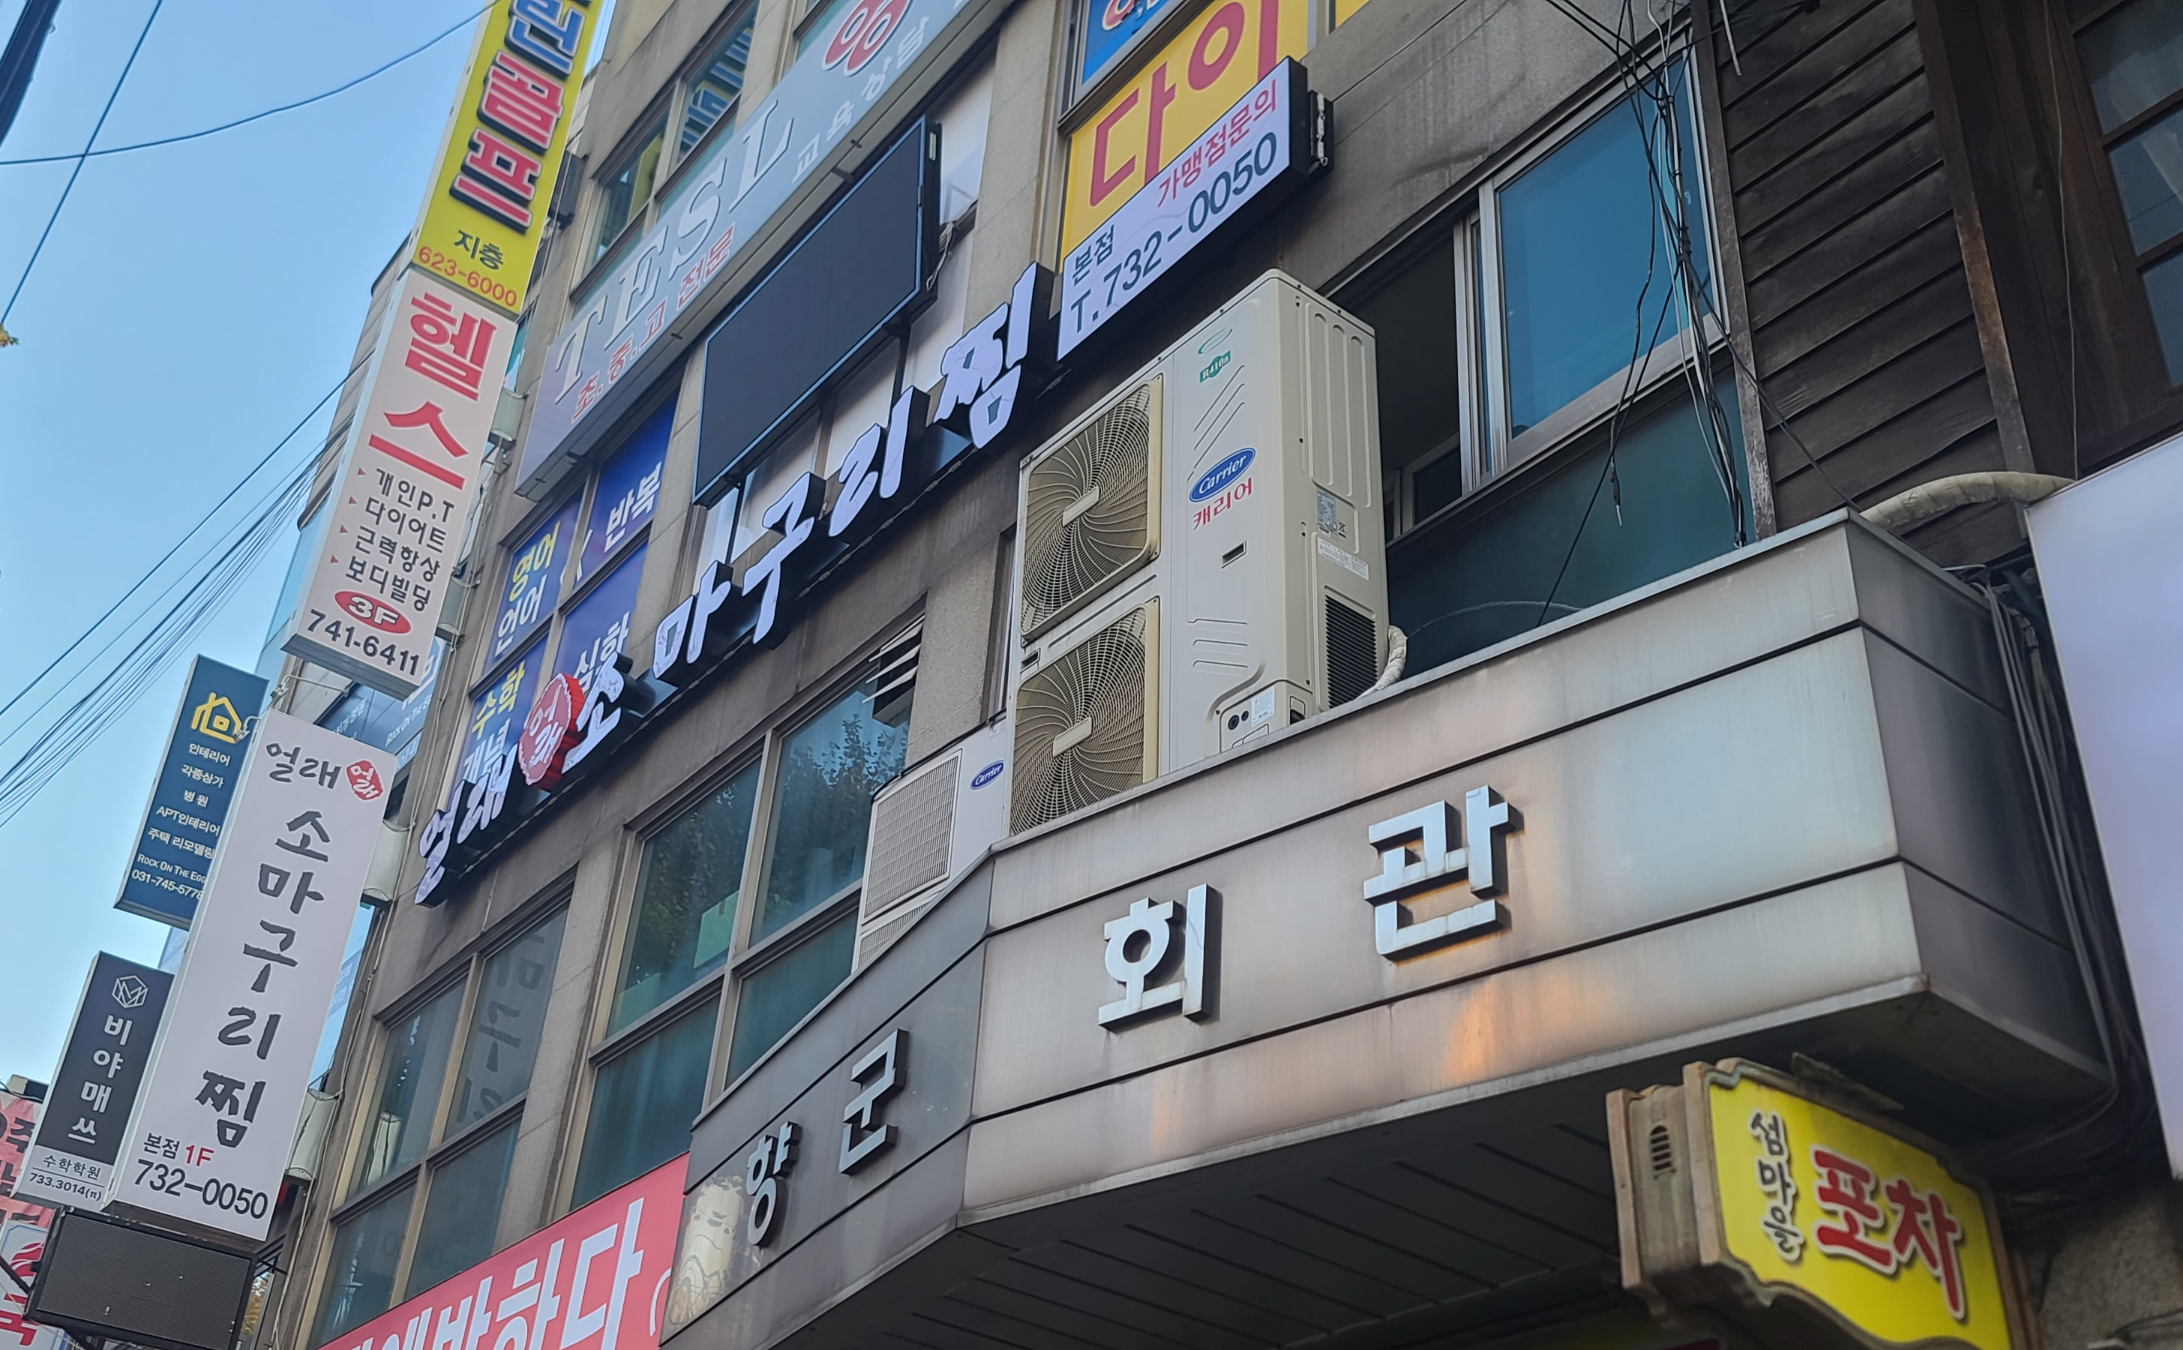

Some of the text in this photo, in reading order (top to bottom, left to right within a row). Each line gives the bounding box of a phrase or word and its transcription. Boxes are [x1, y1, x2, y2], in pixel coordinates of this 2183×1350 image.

[791, 15, 930, 183] 교육상담
[1158, 79, 1276, 208] 가맹점문의
[453, 229, 504, 271] 지층
[555, 99, 794, 405] TESL
[1071, 132, 1277, 333] T.732-0050
[1072, 224, 1115, 286] 본점
[418, 245, 518, 308] 623-6000
[677, 224, 735, 310] 전문
[368, 292, 497, 491] 헬스
[1193, 478, 1252, 530] 캐리어
[1198, 455, 1246, 494] Carrier
[364, 496, 447, 553] 다이어트
[562, 262, 1039, 774] 소마구리찜
[604, 461, 662, 553] 반복
[345, 555, 431, 612] 보디빌딩
[509, 521, 561, 602] 영어
[347, 595, 399, 626] 3F
[495, 574, 547, 657] 언어
[307, 609, 421, 677] 741-6411
[472, 661, 525, 740] 수학
[181, 764, 224, 788] 각종상가
[189, 743, 231, 766] 인테리어
[975, 764, 1003, 786] Carrier
[148, 827, 216, 859] 주택 리모델링
[156, 806, 221, 836] APT인테리어
[195, 811, 330, 1148] 소마구리찜
[68, 1015, 132, 1144] 비야매쓰
[43, 1155, 101, 1180] 수학학원
[143, 1132, 214, 1167] 본점 1F
[134, 1160, 268, 1219] 732-0050
[1812, 1147, 1960, 1316] 포차
